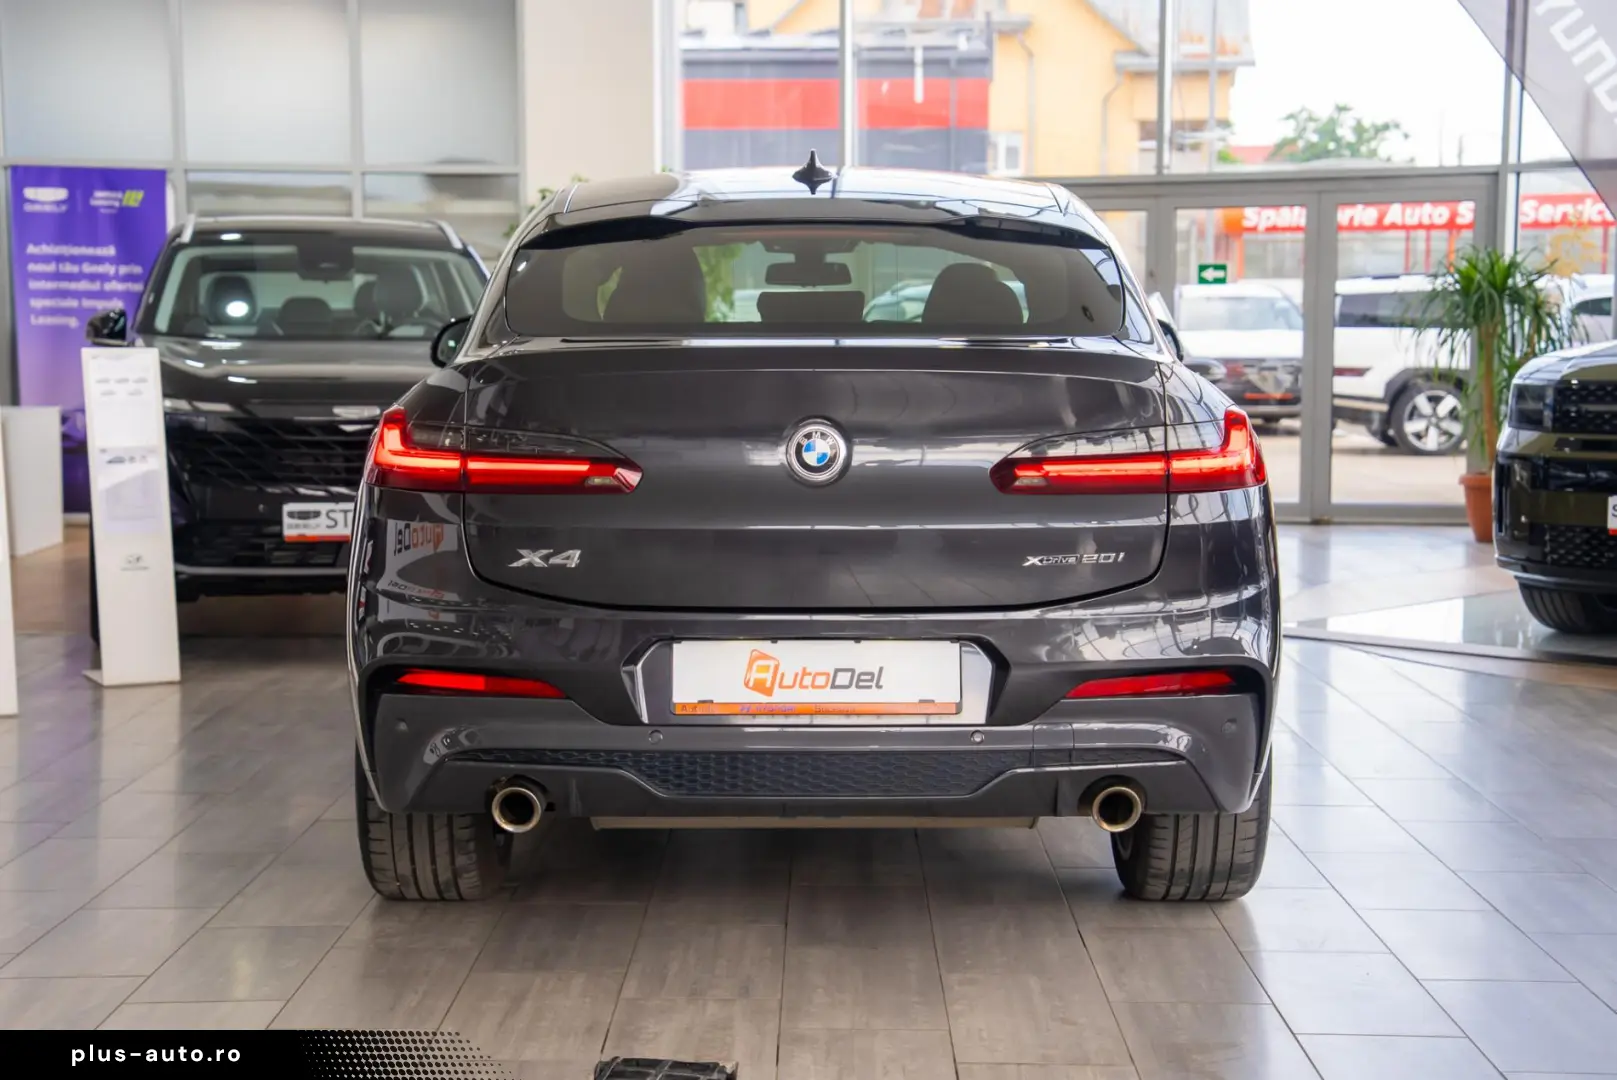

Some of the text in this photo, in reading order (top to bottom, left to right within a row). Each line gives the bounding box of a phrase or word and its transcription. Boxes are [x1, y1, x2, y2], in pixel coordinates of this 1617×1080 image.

[1382, 202, 1450, 226] Auto
[798, 431, 836, 446] BMW
[508, 549, 582, 568] X4
[746, 655, 884, 693] AutoDel
